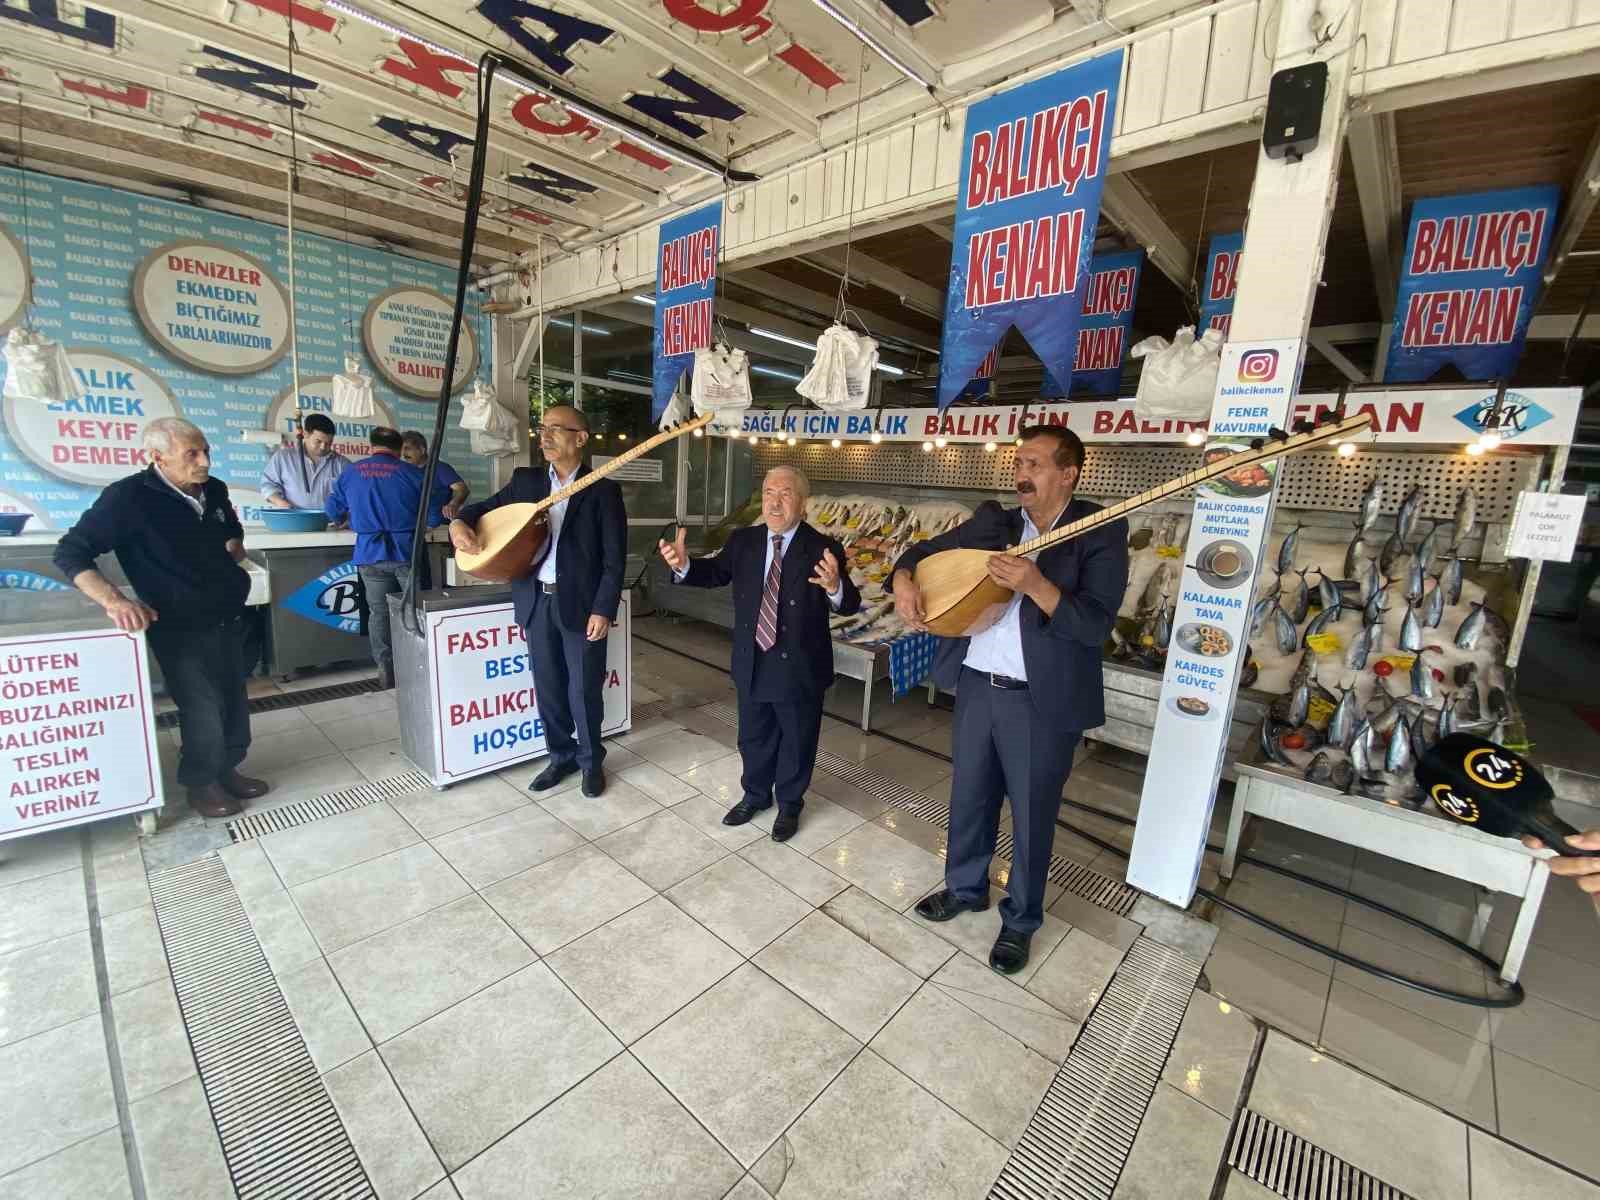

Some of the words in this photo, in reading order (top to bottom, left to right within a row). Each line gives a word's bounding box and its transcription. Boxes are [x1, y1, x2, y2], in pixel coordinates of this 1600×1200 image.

[966, 89, 1108, 210] BALIKÇI
[1408, 207, 1548, 277] BALIKÇI
[660, 224, 718, 294] BALIKÇI
[964, 208, 1085, 311] KENAN
[176, 280, 257, 305] EKMEDEN
[1080, 267, 1137, 321] LIKÇI
[663, 297, 712, 358] KENAN
[1401, 286, 1524, 348] KENAN
[166, 322, 272, 350] TARLALARIMIZDIR
[1072, 326, 1125, 371] NAN
[74, 367, 136, 391] ALIK
[398, 361, 447, 379] BALIKTI
[300, 395, 332, 412] DEN
[1220, 386, 1285, 396] balikcikenan
[742, 411, 798, 433] SAĞLK
[803, 411, 841, 438] İÇİN
[924, 414, 1001, 436] BALIK
[1227, 407, 1270, 418] FENER
[1290, 402, 1425, 433] ENAN
[52, 445, 149, 466] DEMEK
[1205, 514, 1249, 525] MUTLAKA
[1183, 591, 1243, 609] KALAMAR
[1194, 607, 1224, 621] TAVA
[447, 627, 501, 655] FAST
[485, 653, 530, 680] BES
[2, 677, 80, 700] ÖDEME
[1177, 674, 1216, 691] GÜVEÇ
[0, 694, 135, 726] BUZLARINIZI
[450, 688, 535, 727] BALIKÇI
[473, 718, 545, 755] HOŞGE
[13, 746, 89, 772] TESLİM
[10, 767, 100, 798] ALIRKEN
[15, 790, 100, 820] VERİNİZ
